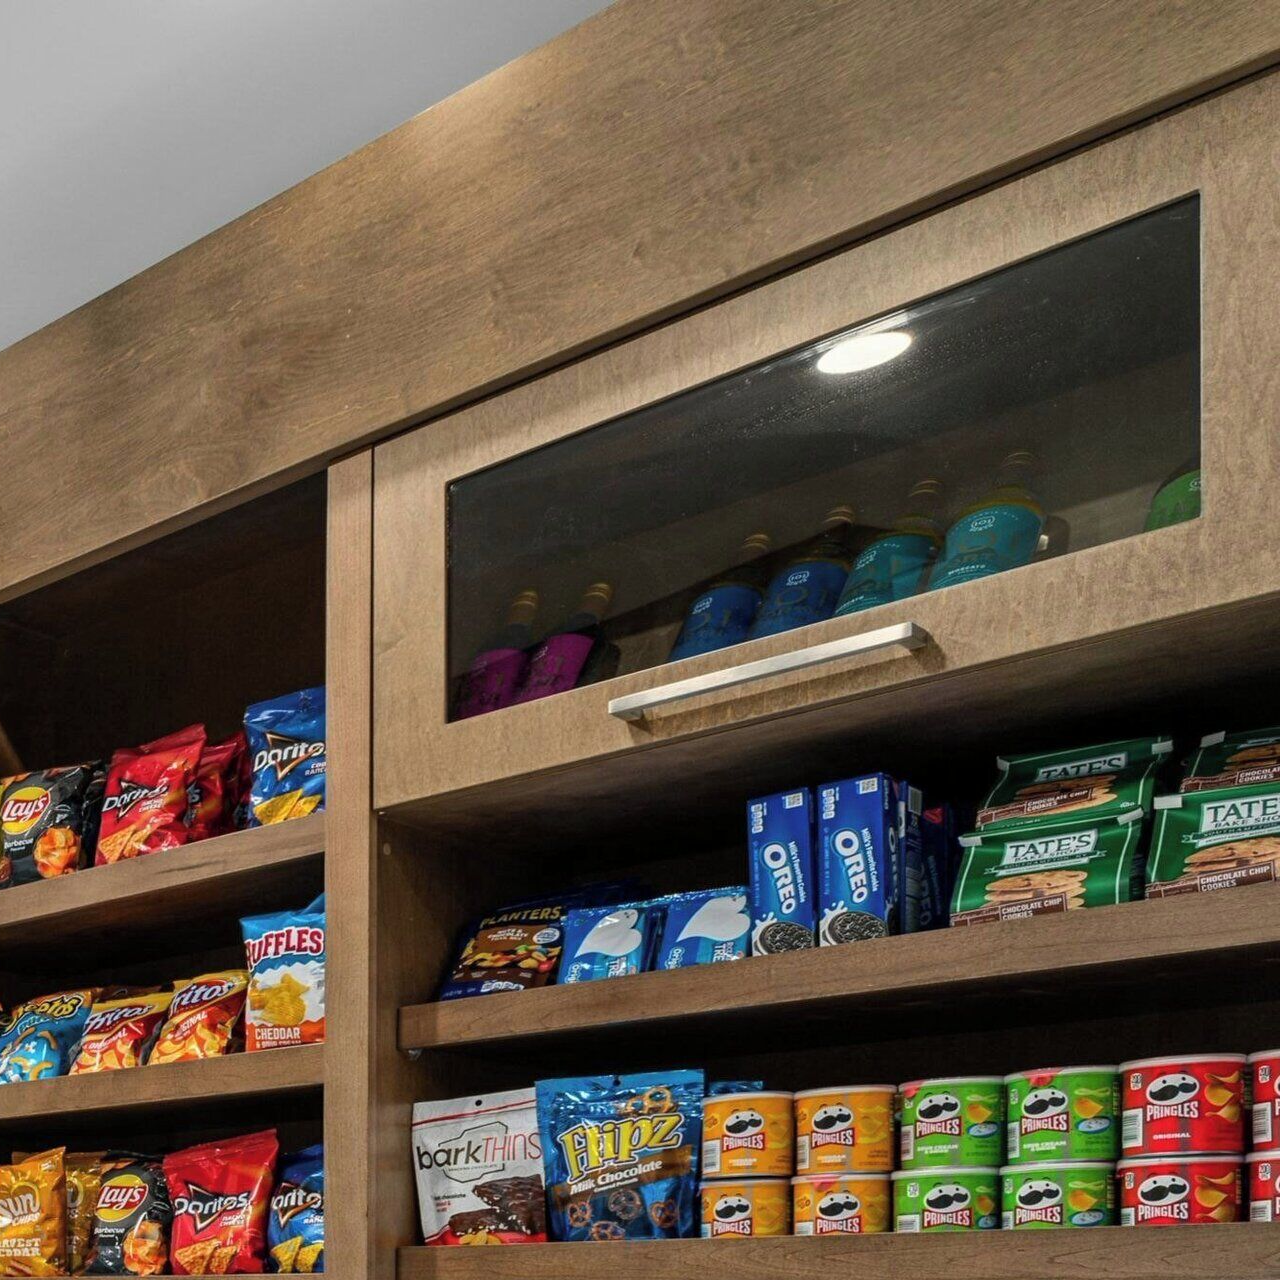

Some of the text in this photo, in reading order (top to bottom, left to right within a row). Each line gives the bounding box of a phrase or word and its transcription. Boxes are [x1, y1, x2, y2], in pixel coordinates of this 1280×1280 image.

[253, 740, 326, 773] Dorito
[1041, 755, 1125, 779] TATE'S
[1240, 773, 1274, 783] COOKIES
[102, 782, 169, 813] Doritos
[1027, 800, 1059, 811] COOKIES
[1028, 789, 1089, 808] CHOCOLATE CHIP
[2, 796, 48, 823] Lay's
[1207, 796, 1280, 823] TATE
[1214, 818, 1249, 829] BAKE
[1008, 833, 1093, 857] TATE'S
[834, 829, 869, 904] OREO
[865, 846, 880, 892] Favorite Cookie
[1200, 865, 1270, 884] CHOCOLATE CHIP
[762, 843, 796, 915] OREO
[792, 860, 806, 903] Favorite Cookie
[1201, 879, 1237, 892] COOKIES
[1001, 897, 1063, 914] CHOCOLATE CHIP
[480, 906, 562, 928] PLANTERS
[1002, 911, 1033, 921] COOKIES
[245, 927, 324, 971] RUFFLES
[254, 1028, 301, 1040] CHEDDAR
[1146, 1100, 1200, 1122] PRINGLES
[916, 1118, 960, 1137] PRINGLES
[1021, 1113, 1069, 1135] PRINGLES
[722, 1134, 764, 1150] PRINGLES
[811, 1129, 853, 1147] PRINGLES
[1152, 1131, 1191, 1140] ORIGINAL
[559, 1114, 683, 1182] Flipz
[570, 1158, 663, 1195] Milk Chocolate
[96, 1185, 147, 1211] Lay's
[174, 1191, 250, 1217] Doritos
[11, 1214, 40, 1227] CHIPS
[924, 1209, 971, 1227] PRINGLES
[1015, 1206, 1062, 1224] PRINGLES
[1137, 1201, 1190, 1221] PRINGLES
[94, 1226, 125, 1235] Barbecue
[713, 1219, 752, 1234] PRINGLES
[815, 1217, 860, 1233] PRINGLES
